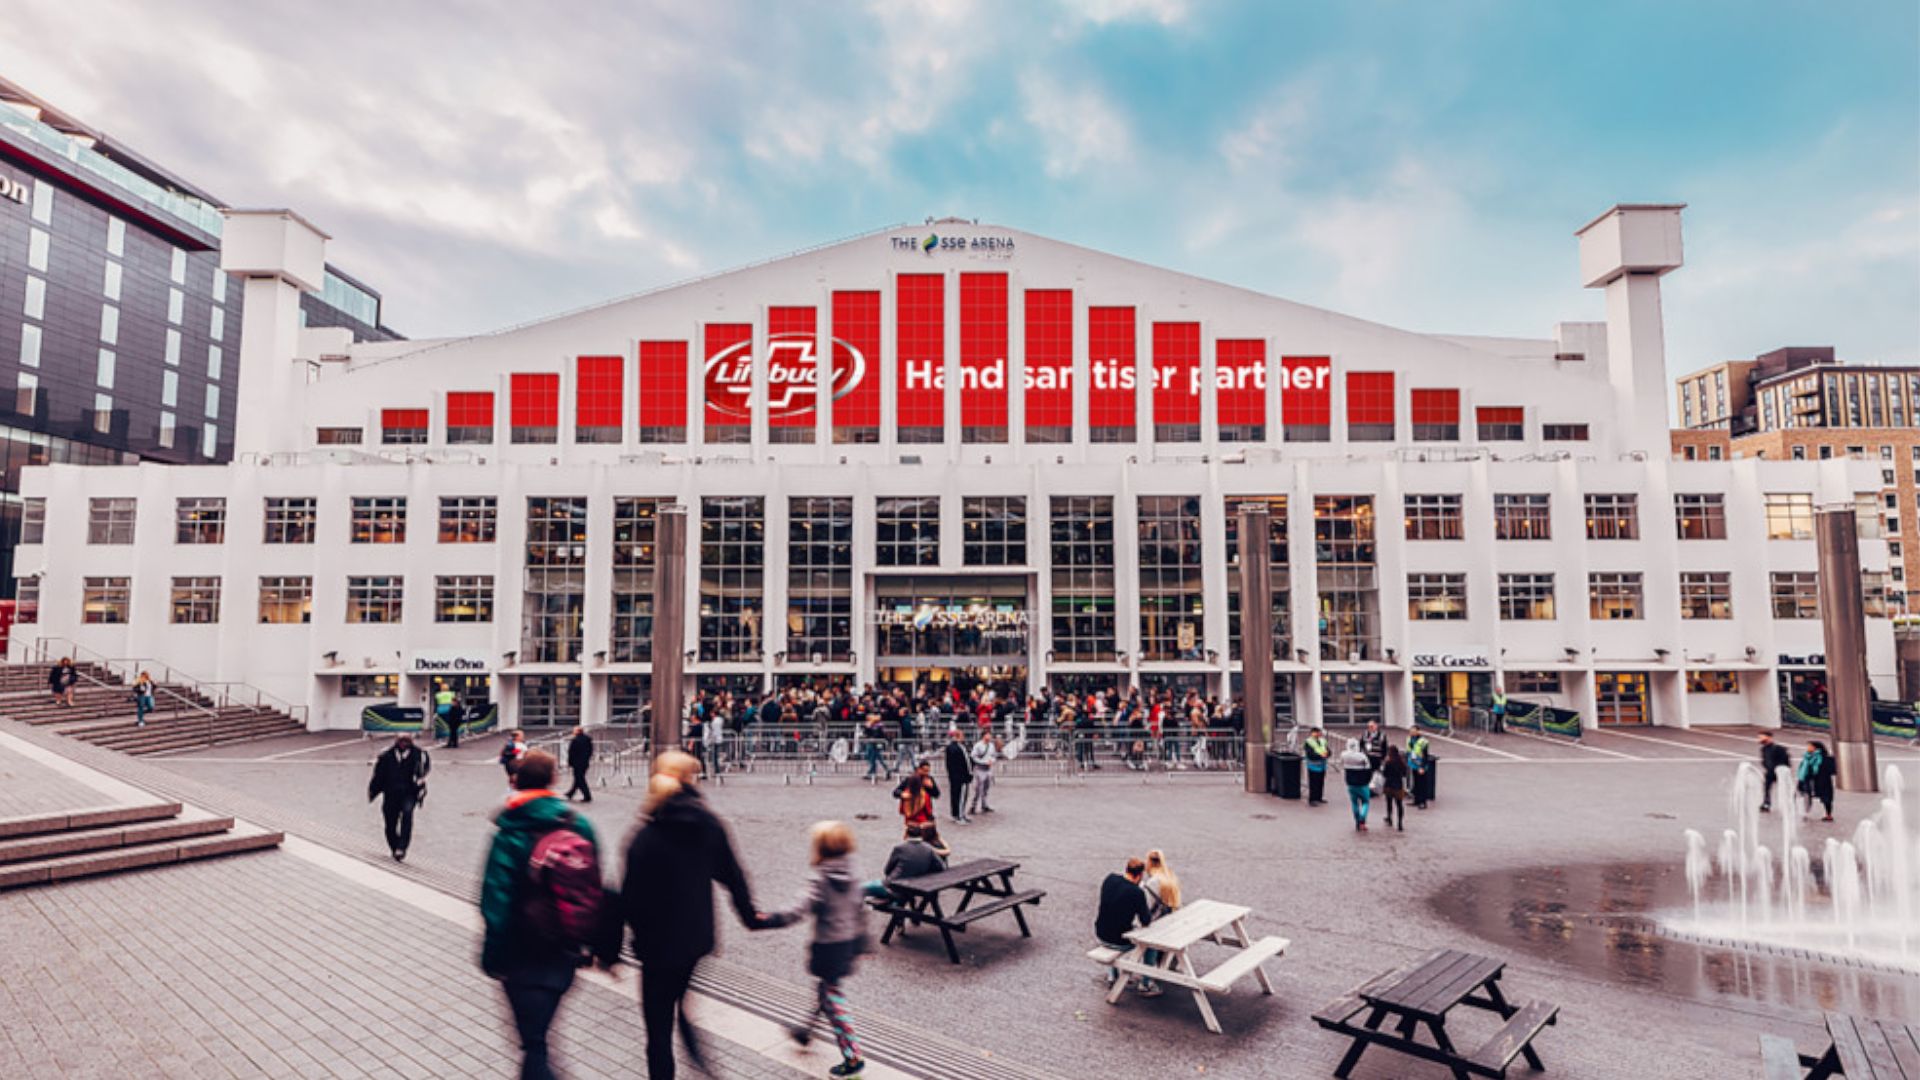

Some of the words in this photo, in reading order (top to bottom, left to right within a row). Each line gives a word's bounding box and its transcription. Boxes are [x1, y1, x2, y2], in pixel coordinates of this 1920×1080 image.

[891, 237, 917, 249] THE
[971, 237, 1015, 249] ARENA
[906, 359, 1004, 389] Hand
[876, 611, 911, 625] THE
[975, 611, 1030, 625] ARENA
[415, 658, 450, 670] Door
[454, 658, 484, 670] One
[1413, 655, 1440, 667] SSE
[1441, 655, 1489, 667] Guests
